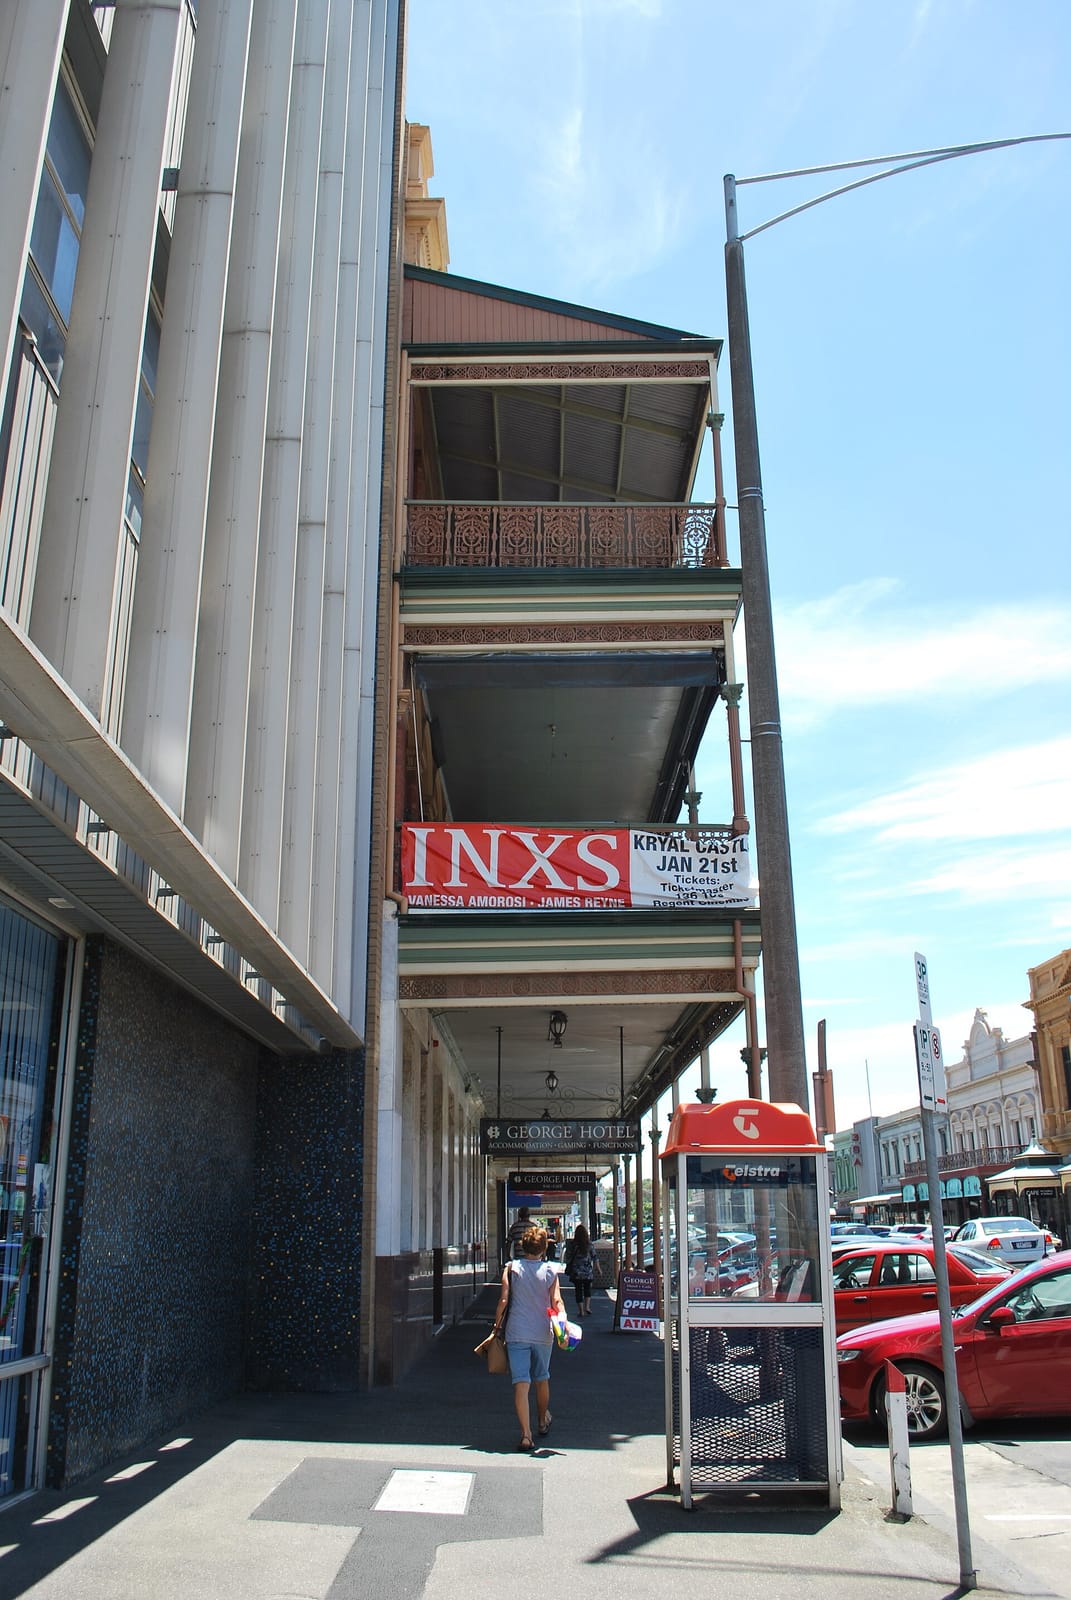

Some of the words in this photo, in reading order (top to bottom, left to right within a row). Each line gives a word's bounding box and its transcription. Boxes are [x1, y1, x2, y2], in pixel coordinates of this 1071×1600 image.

[633, 834, 690, 853] KRYAL
[695, 838, 750, 855] CASTL
[405, 827, 621, 892] INXS
[656, 855, 692, 873] JAN
[698, 857, 738, 874] 21st
[673, 874, 720, 885] Tickets:
[407, 894, 465, 907] VANESSA
[468, 895, 526, 908] AMOROSI
[537, 896, 581, 908] JAMES
[584, 897, 625, 908] REYNE
[506, 1125, 573, 1139] GEORGE
[580, 1125, 636, 1139] HOTEL
[488, 1141, 553, 1149] ACCOMMODATION
[593, 1141, 635, 1149] FUNCTIONS
[523, 1175, 561, 1183] GEORGE
[562, 1175, 593, 1183] HOTEL
[722, 1164, 781, 1182] Telstra
[623, 1299, 656, 1310] OPEN
[623, 1318, 653, 1329] ATM
